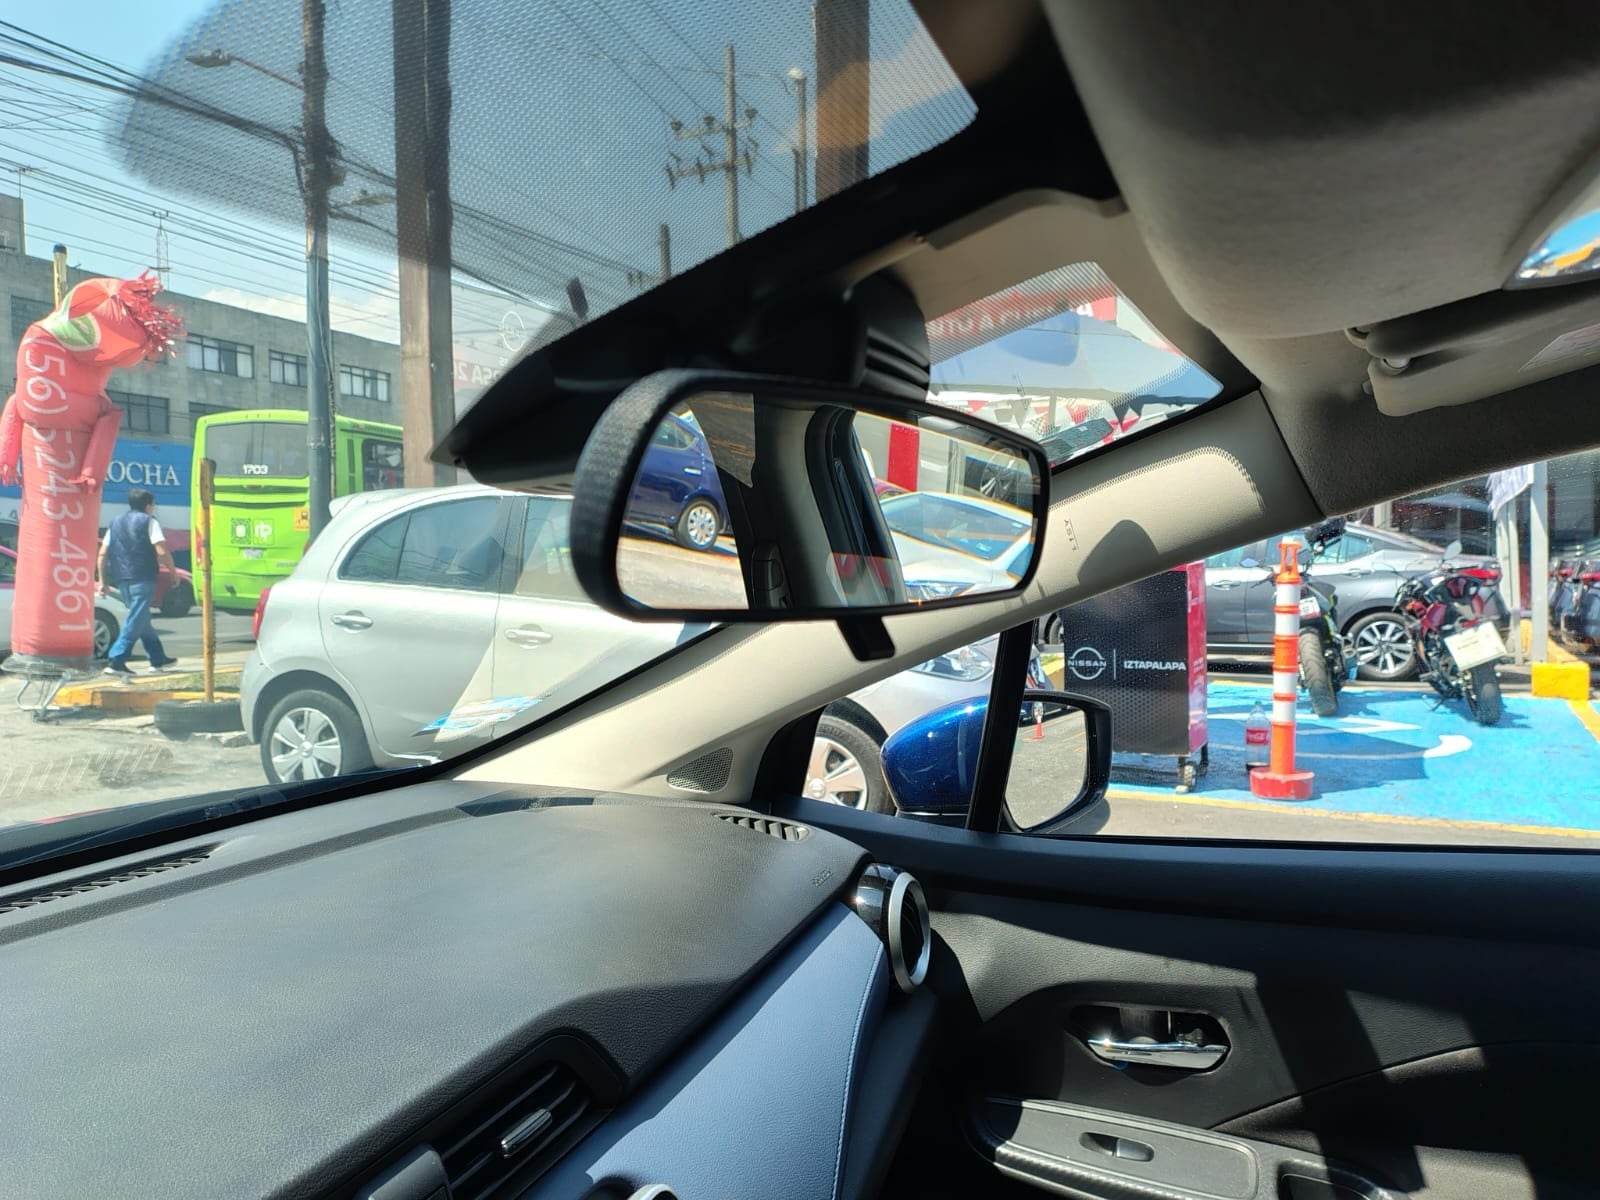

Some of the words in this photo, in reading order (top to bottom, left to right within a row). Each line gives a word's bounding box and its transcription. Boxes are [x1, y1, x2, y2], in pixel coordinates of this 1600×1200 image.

[104, 459, 181, 487] OCHA
[1067, 659, 1107, 668] NISSAN
[1123, 660, 1187, 671] IZTAPALAPA
